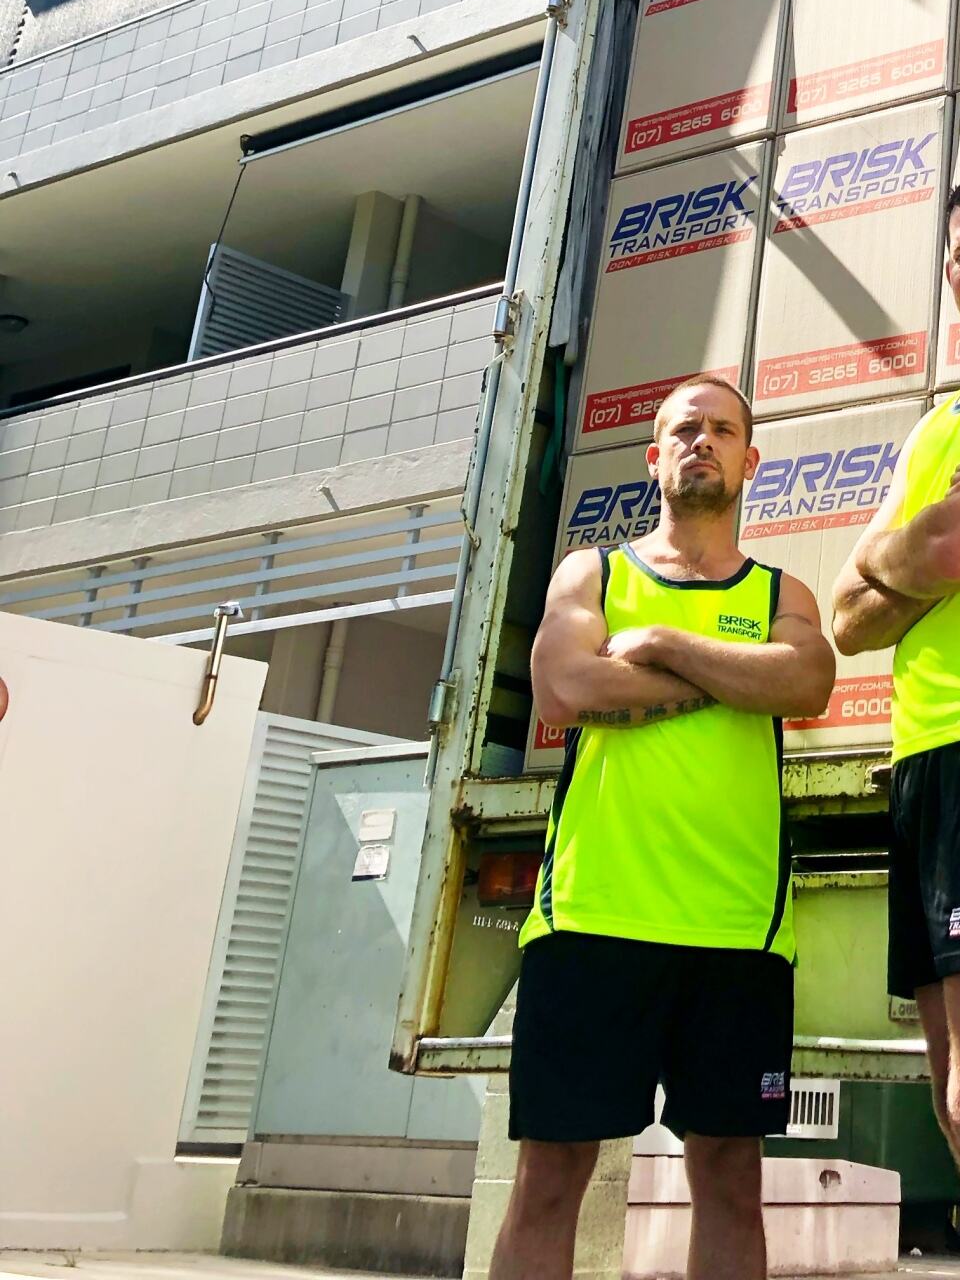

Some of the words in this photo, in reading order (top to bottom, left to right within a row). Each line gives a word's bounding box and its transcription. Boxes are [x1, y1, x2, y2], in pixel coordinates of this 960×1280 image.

[776, 132, 938, 201] BRISK
[610, 175, 758, 242] BRISK
[775, 168, 935, 218] TRANSPORT
[609, 210, 754, 258] TRANSPORT
[760, 369, 800, 397] (07)
[808, 362, 858, 386] 3265
[868, 352, 916, 375] 6000
[588, 403, 623, 428] (07)
[630, 398, 665, 418] 326
[745, 442, 901, 503] BRISK
[568, 480, 661, 528] BRI
[745, 485, 891, 522] TRANSPO
[566, 520, 660, 547] TRANS
[717, 624, 762, 641] TRANSPORT
[718, 614, 762, 632] BRISK
